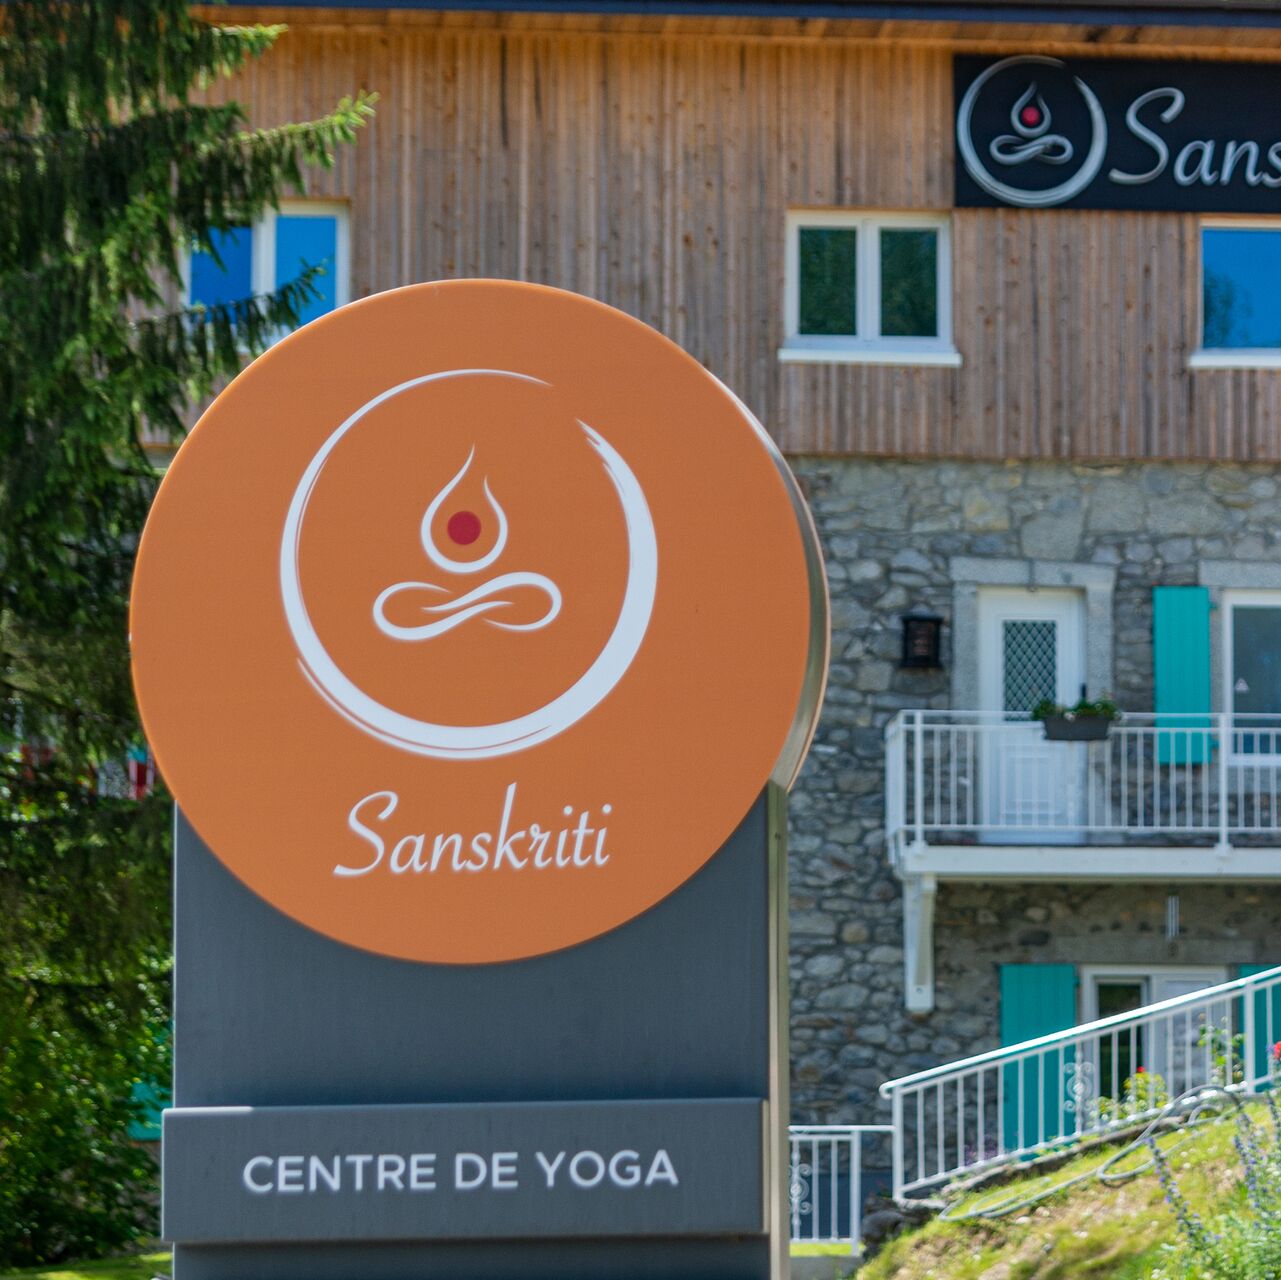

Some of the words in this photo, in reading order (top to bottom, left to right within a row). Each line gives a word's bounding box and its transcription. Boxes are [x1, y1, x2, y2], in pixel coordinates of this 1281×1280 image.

[333, 782, 612, 877] Sanskriti
[242, 1153, 437, 1194] CENTRE
[455, 1151, 518, 1189] DE
[535, 1148, 679, 1189] YOGA
